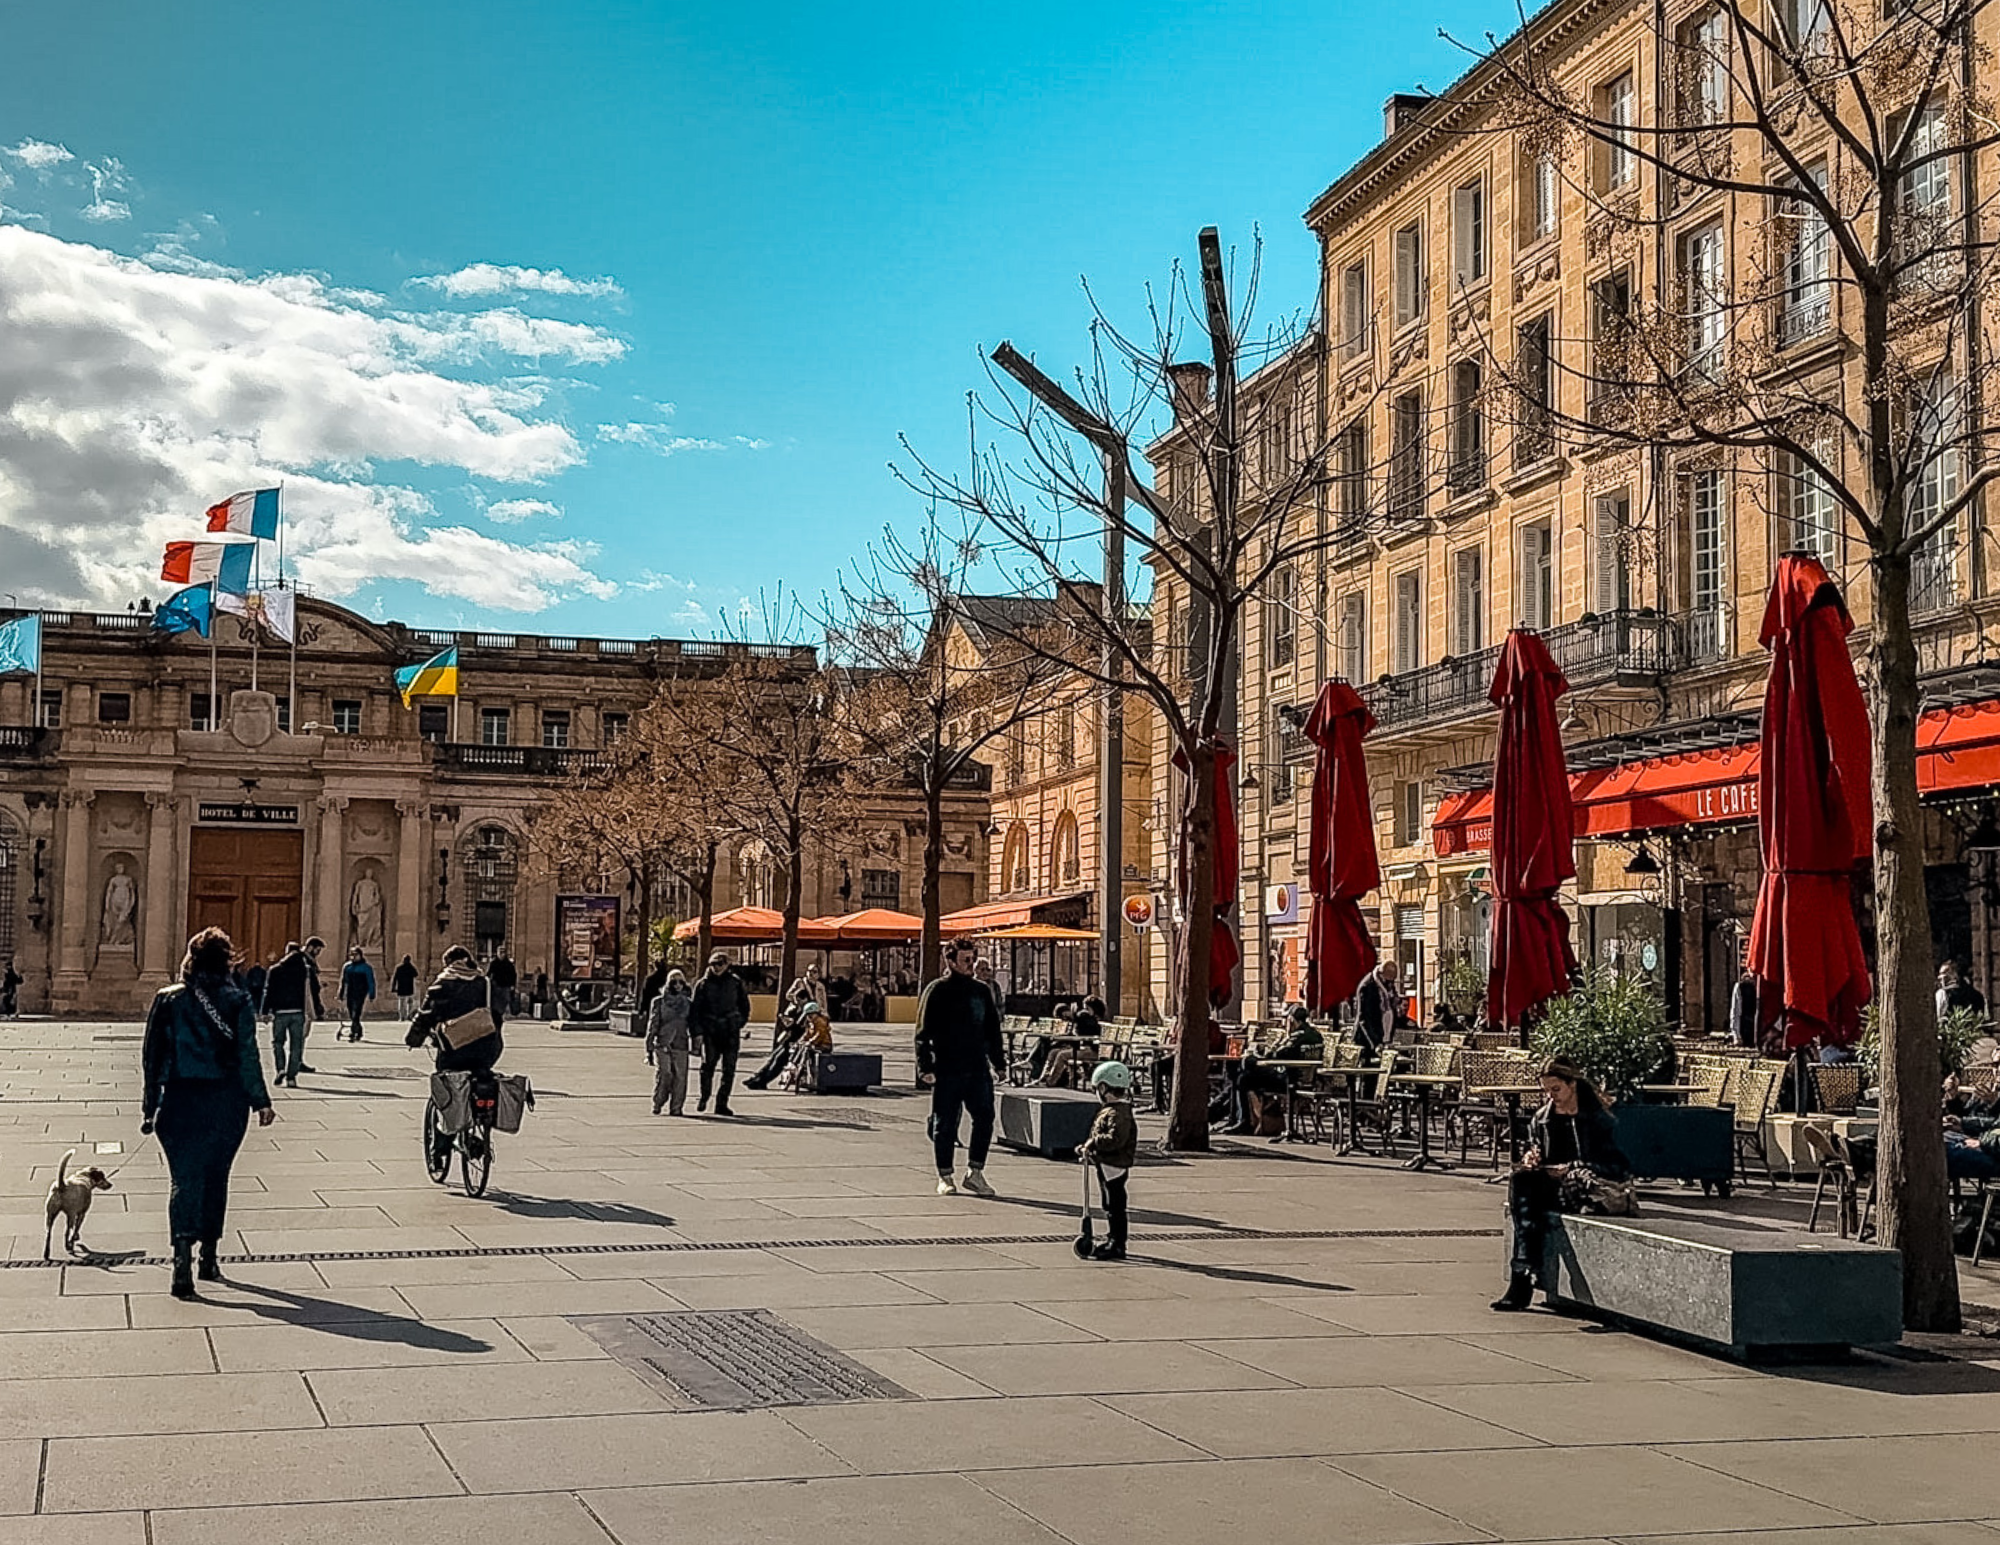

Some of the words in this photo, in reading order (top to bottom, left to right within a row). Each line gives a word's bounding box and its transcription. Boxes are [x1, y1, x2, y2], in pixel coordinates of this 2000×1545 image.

[1697, 789, 1713, 817] LE
[1720, 783, 1758, 815] CAFÉ
[242, 809, 256, 819] DE
[262, 809, 297, 820] VILLE
[1129, 911, 1148, 920] PFG
